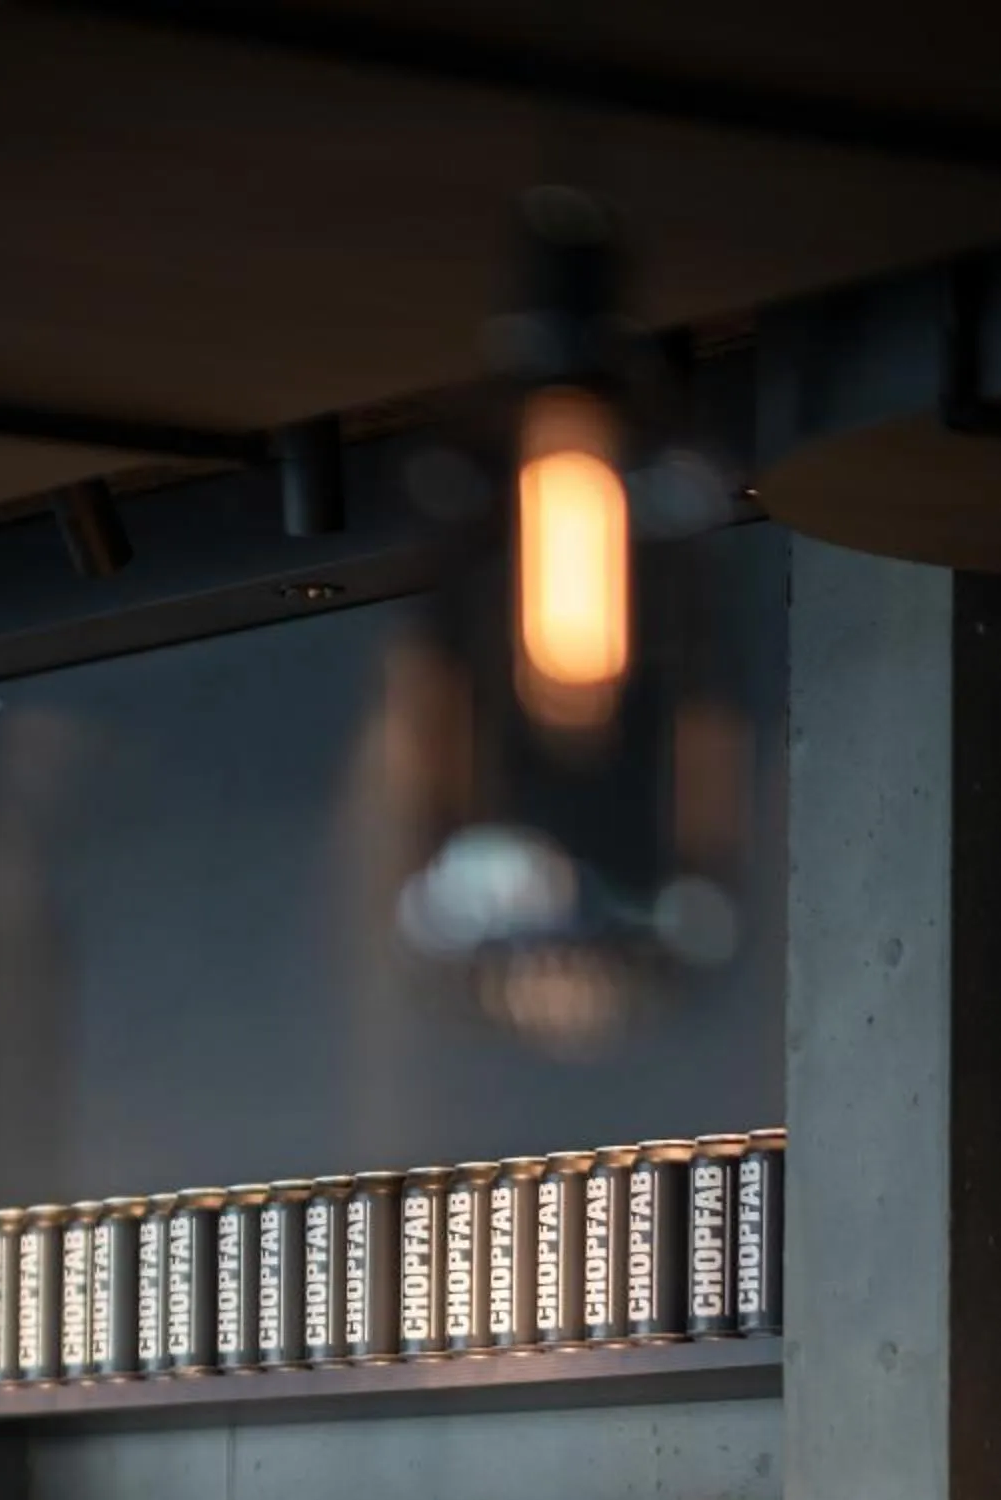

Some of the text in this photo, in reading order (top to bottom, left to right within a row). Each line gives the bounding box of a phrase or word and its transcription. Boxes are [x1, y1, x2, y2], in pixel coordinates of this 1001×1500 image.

[19, 1234, 37, 1366] CHOPFAB
[63, 1229, 84, 1363] CHOPFAB
[92, 1226, 108, 1360] CHOPFAB
[139, 1223, 157, 1359] CHOPFAB
[168, 1217, 190, 1355] CHOPFAB
[218, 1215, 238, 1352] CHOPFAB
[259, 1209, 278, 1348] CHOPFAB
[306, 1205, 327, 1345] CHOPFAB
[346, 1201, 364, 1343] CHOPFAB
[403, 1197, 430, 1340] CHOPFAB
[448, 1192, 471, 1336] CHOPFAB
[490, 1187, 511, 1333] CHOPFAB
[537, 1182, 558, 1329] CHOPFAB
[585, 1177, 607, 1324] CHOPFAB
[629, 1171, 652, 1320] CHOPFAB
[693, 1167, 723, 1317] CHOPFAB
[738, 1161, 760, 1313] CHOPFAB
